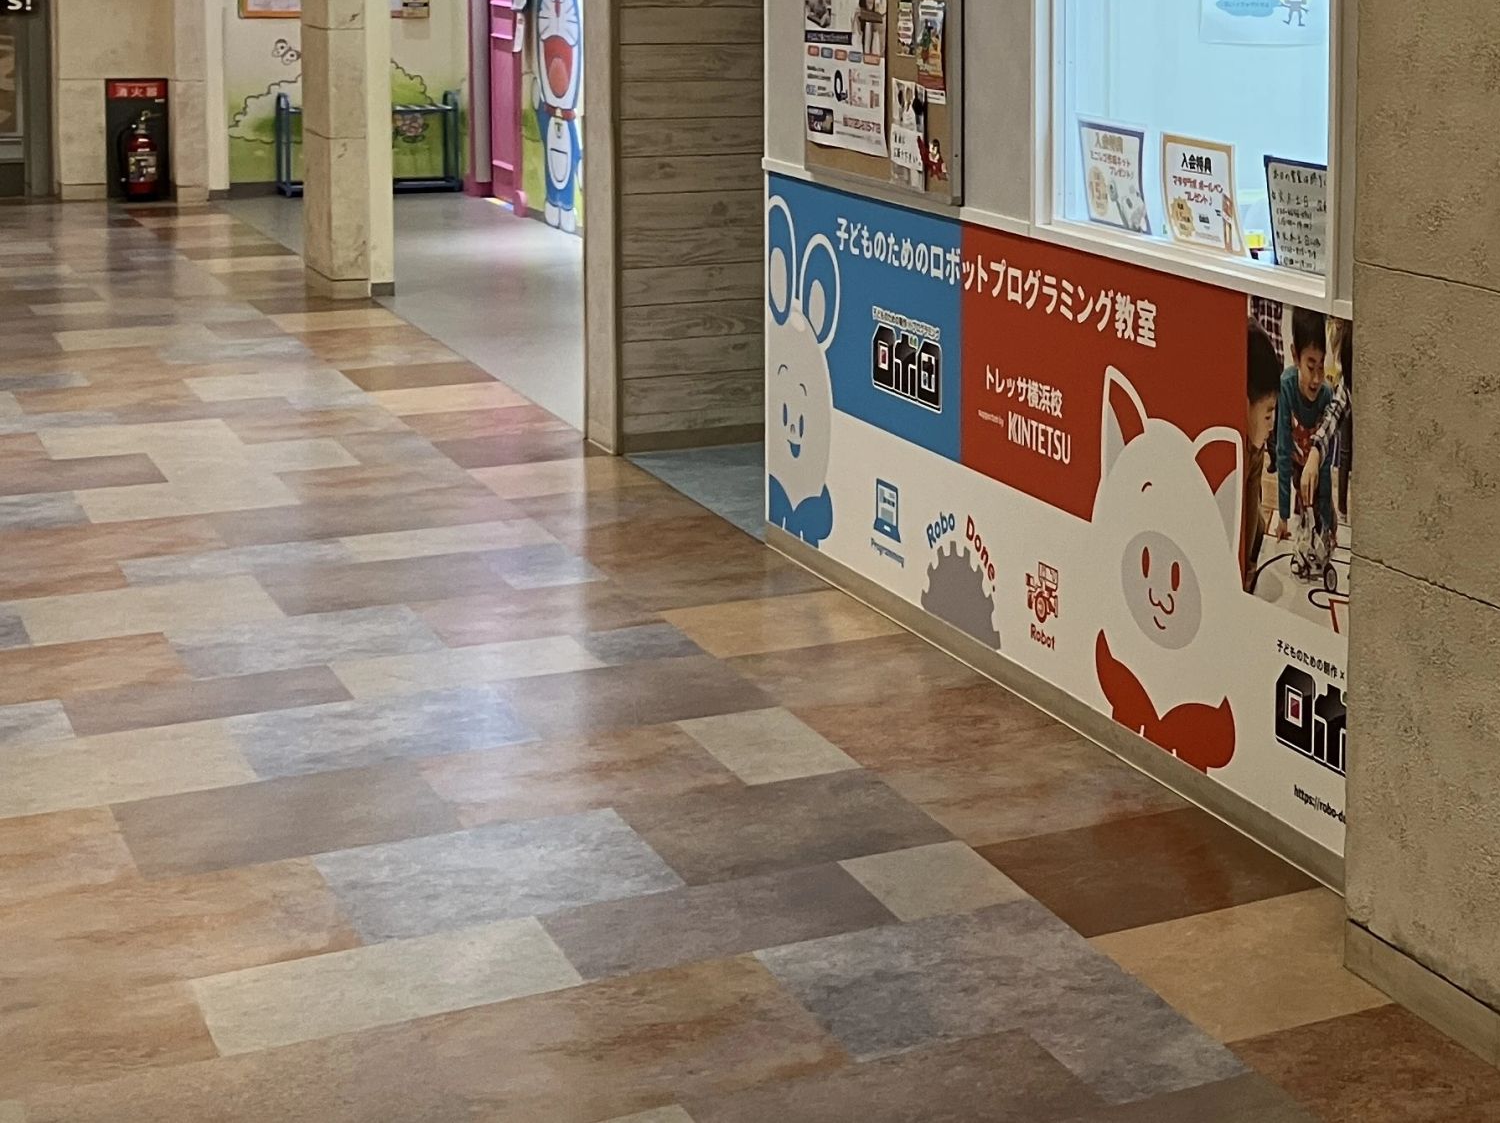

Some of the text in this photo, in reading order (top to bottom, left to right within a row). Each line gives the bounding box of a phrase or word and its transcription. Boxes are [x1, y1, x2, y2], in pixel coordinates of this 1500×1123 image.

[115, 86, 158, 98] 消火器
[836, 217, 1157, 348] 子どものためのロボットプログラミング教室
[986, 364, 1062, 419] トレッサ横浜校
[1008, 410, 1071, 465] KINTETSU
[926, 511, 956, 549] Robo
[1031, 623, 1056, 651] Robot
